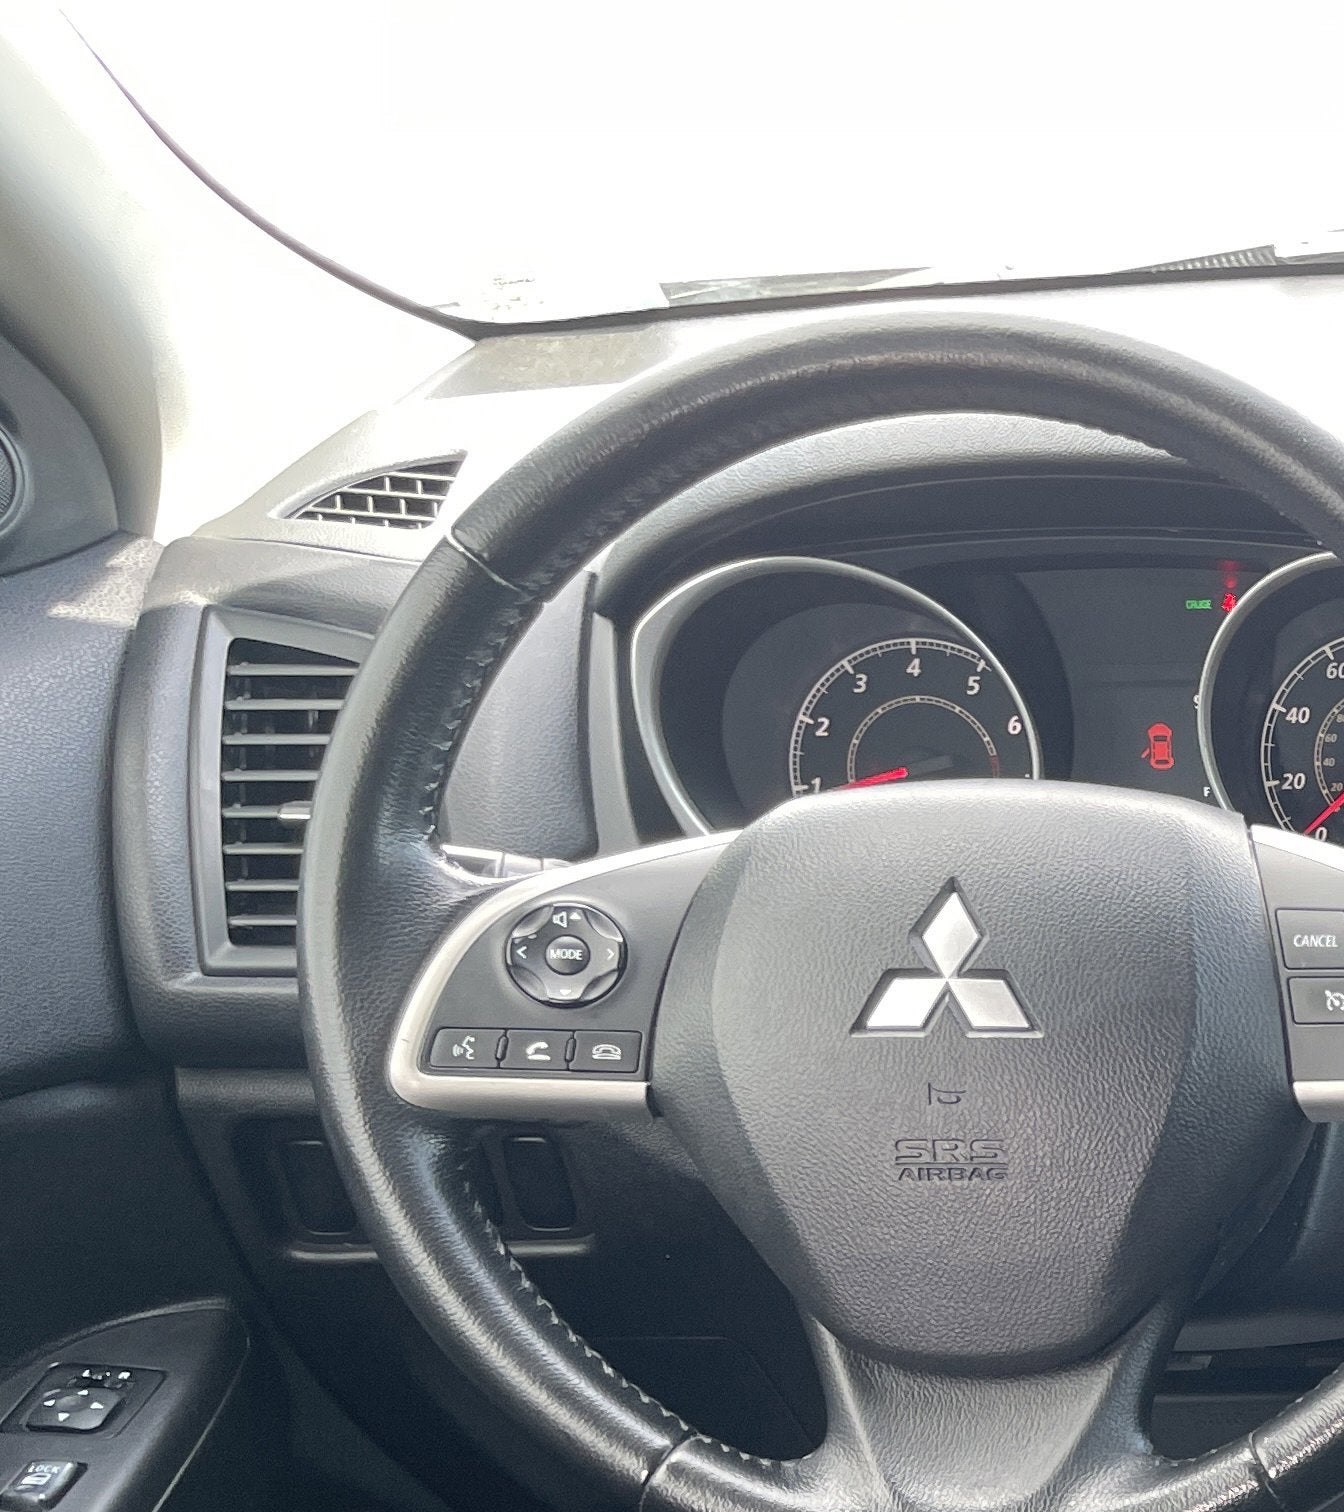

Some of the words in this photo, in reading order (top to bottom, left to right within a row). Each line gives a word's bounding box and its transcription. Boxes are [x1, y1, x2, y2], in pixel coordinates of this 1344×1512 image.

[906, 658, 921, 677] 4
[852, 673, 868, 693] 3
[966, 675, 981, 695] 5
[1285, 706, 1310, 724] 40
[815, 717, 830, 736] 2
[1007, 715, 1022, 735] 6
[1325, 733, 1338, 743] 60
[1323, 757, 1336, 767] 40
[811, 776, 822, 793] 1
[1281, 772, 1306, 790] 20
[1330, 782, 1343, 792] 20
[1203, 786, 1212, 797] F
[1315, 826, 1327, 841] 0
[1293, 934, 1338, 948] CANCEL
[550, 948, 583, 961] MODE
[894, 1138, 1006, 1162] SRS
[898, 1167, 1009, 1182] AIRBAG
